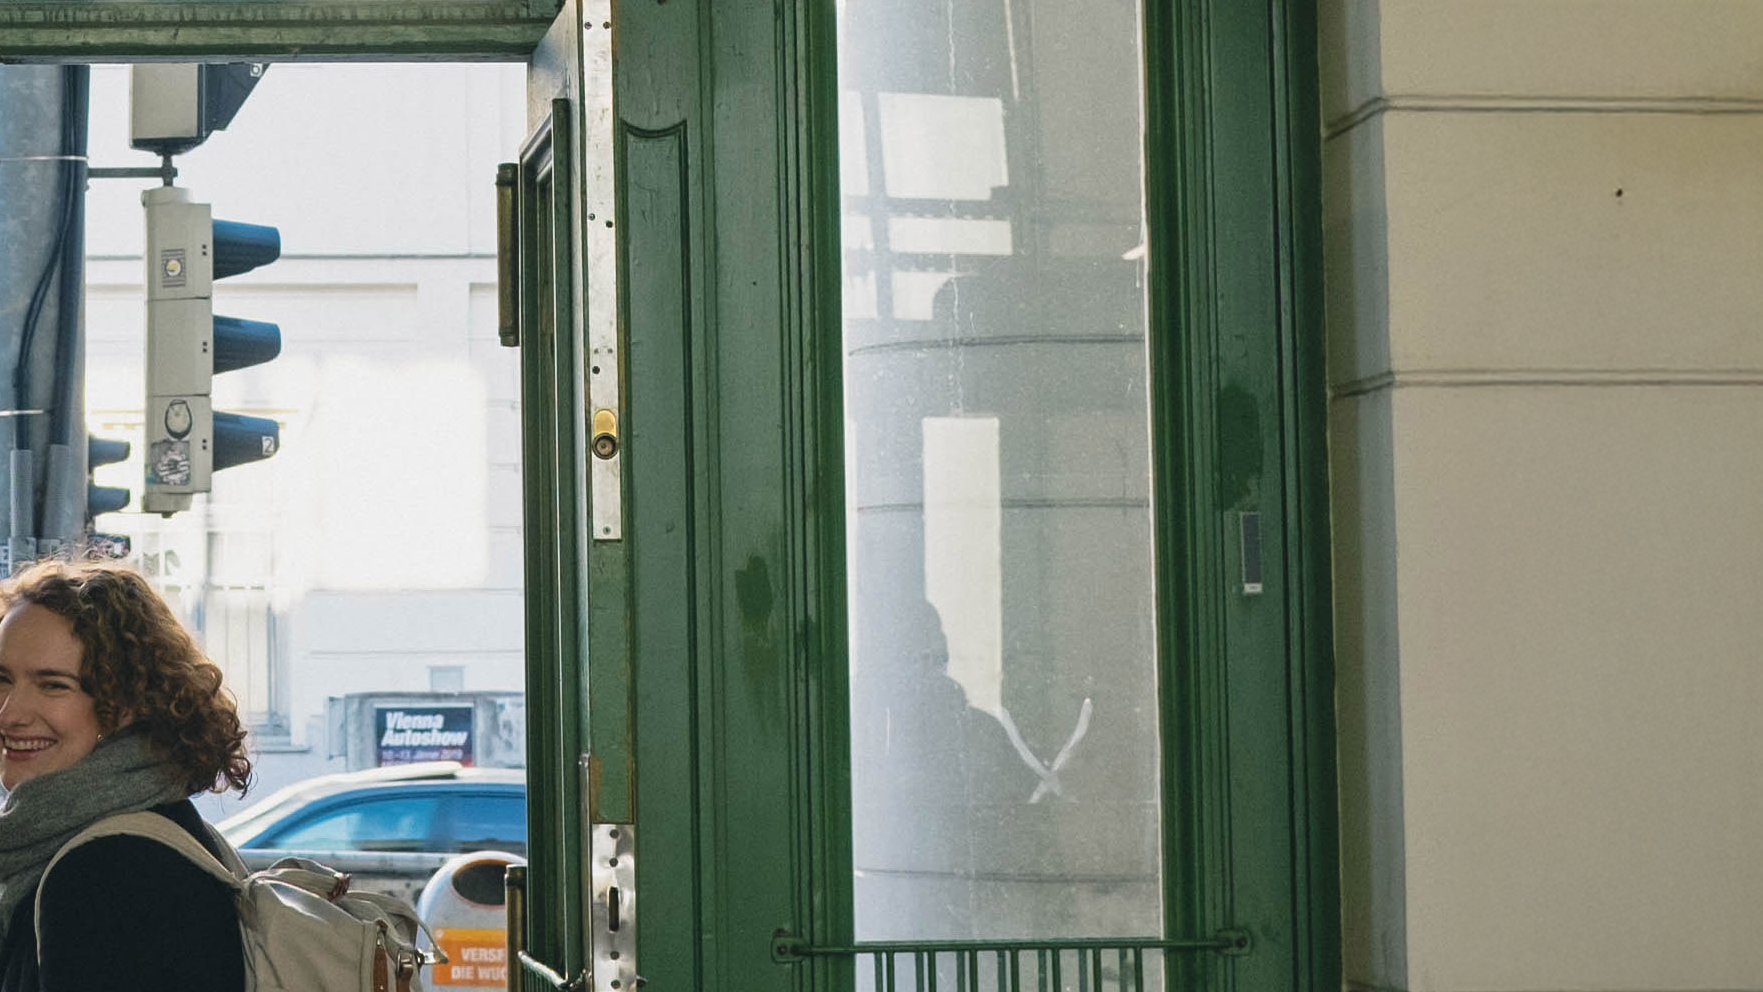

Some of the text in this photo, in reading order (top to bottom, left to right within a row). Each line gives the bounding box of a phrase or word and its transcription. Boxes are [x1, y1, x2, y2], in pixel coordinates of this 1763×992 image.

[264, 437, 273, 453] 2
[386, 711, 444, 729] Vienna
[381, 729, 468, 746] Autoshow
[451, 965, 474, 980] DIE
